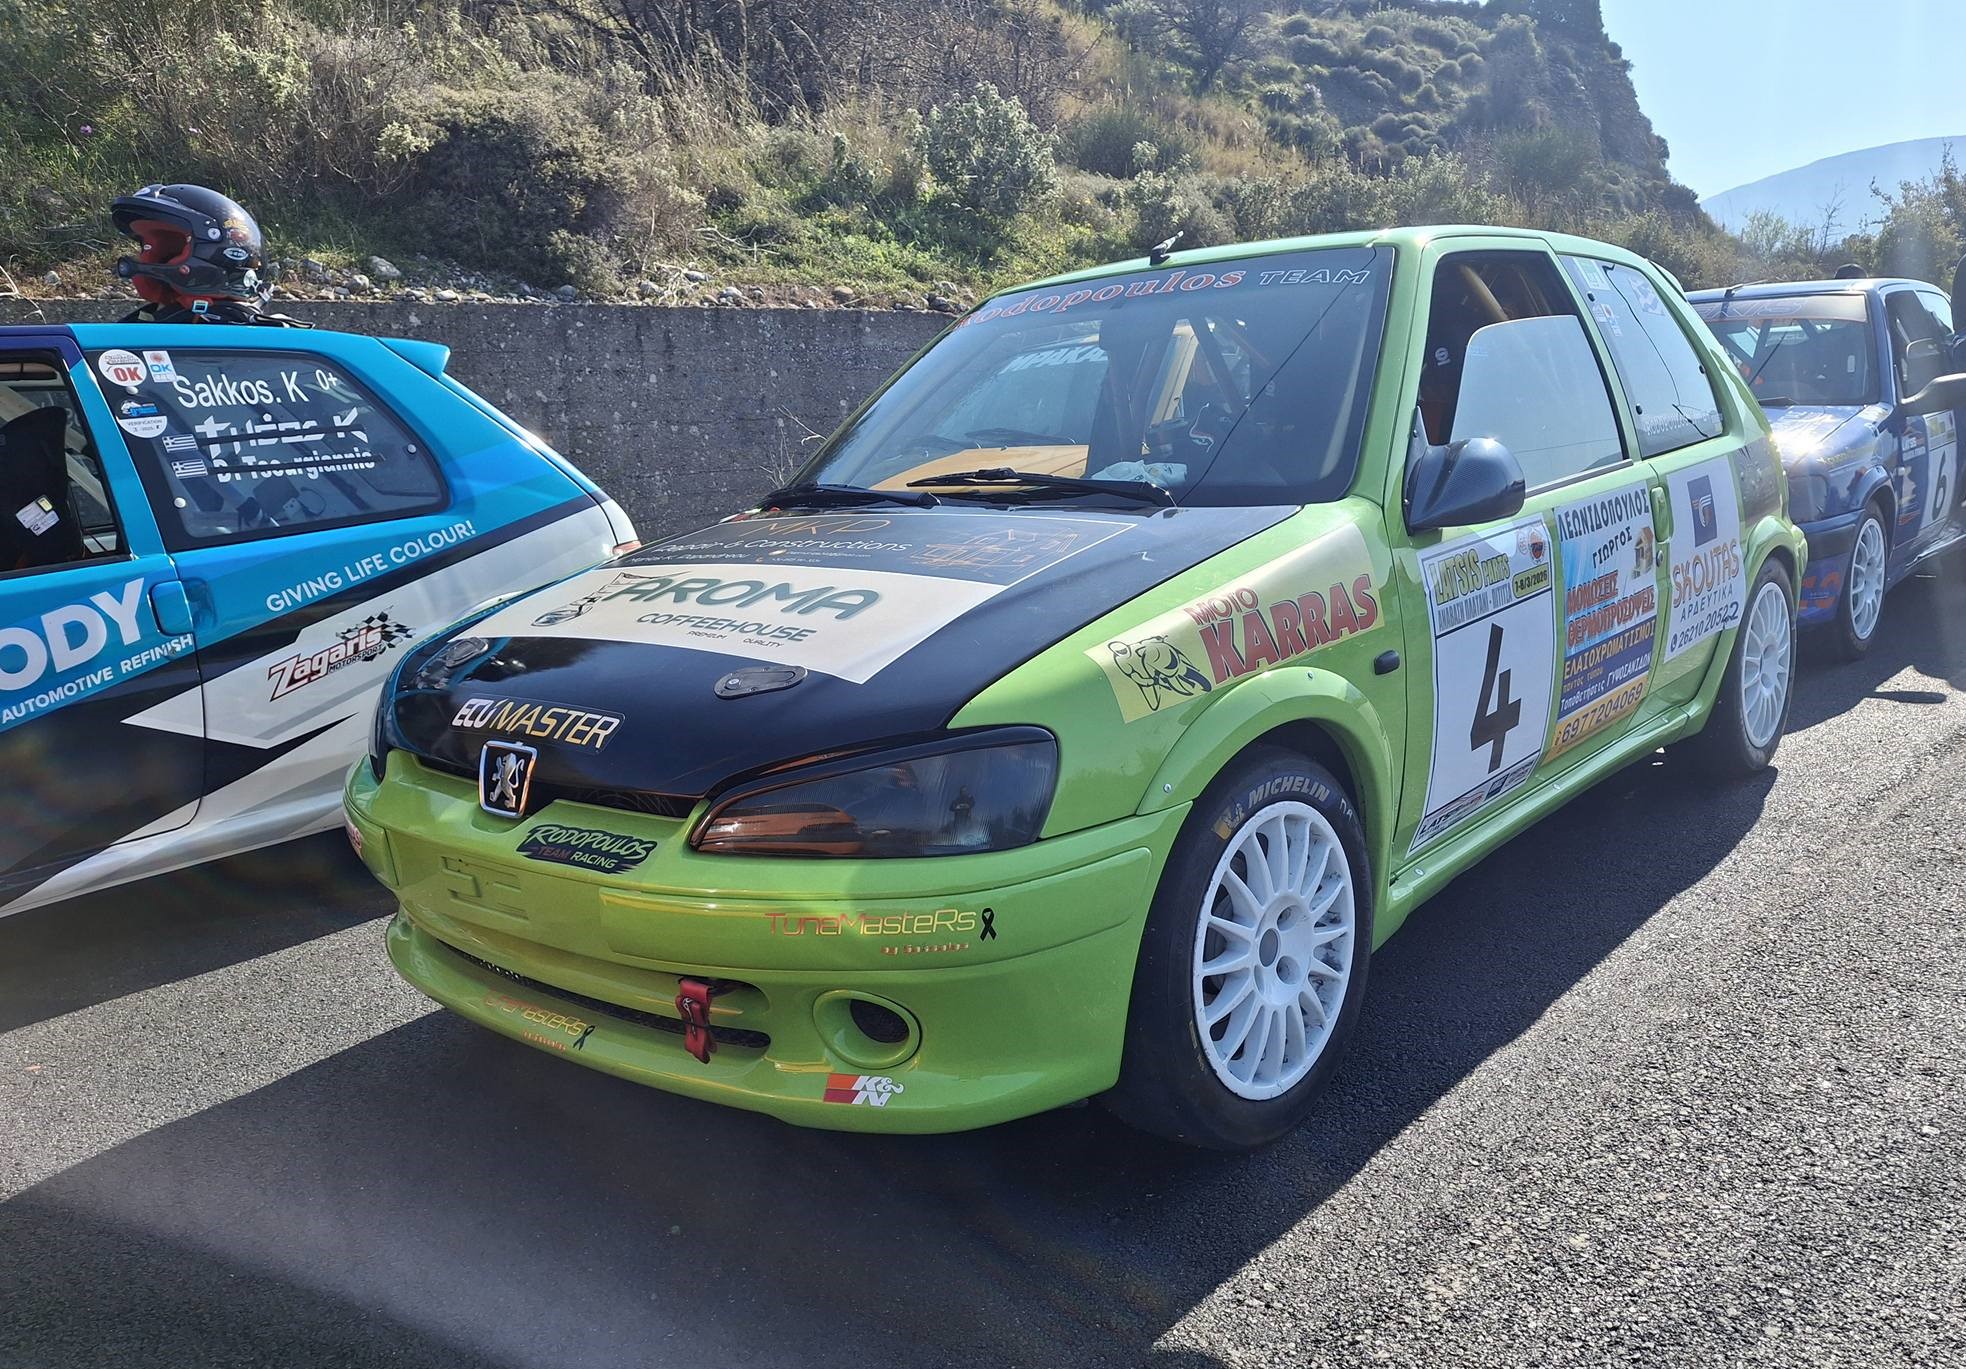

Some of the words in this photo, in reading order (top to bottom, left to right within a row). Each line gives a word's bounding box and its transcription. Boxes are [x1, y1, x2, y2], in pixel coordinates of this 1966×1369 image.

[1259, 269, 1370, 286] TEAM
[113, 367, 143, 382] OK
[149, 364, 172, 373] OK
[173, 375, 280, 408] Sakkos.
[281, 370, 309, 403] K
[1933, 450, 1948, 521] 6
[1557, 488, 1650, 542] ΛΕΩΝΙΔΟΠΟΥΛΟΣ
[266, 571, 343, 612] GIVING
[344, 553, 388, 582] LIFE
[389, 519, 477, 564] COLOUR!
[744, 540, 913, 552] Constructions
[1592, 526, 1633, 568] ΓΙΩΡΓΟΣ
[1428, 548, 1483, 606] LATSIS
[1481, 552, 1511, 588] PARTS
[1672, 538, 1739, 609] SKOUTAS
[600, 578, 880, 620] AROMA
[1184, 586, 1259, 626] MOTO
[1680, 583, 1734, 622] ΑΡΔΕΥΤΙΚΑ
[637, 613, 818, 642] COFFEEHOUSE
[1199, 573, 1379, 685] KARRAS
[268, 626, 384, 702] Zagaris
[328, 643, 386, 673] MOTORSPORT
[1563, 619, 1656, 680] ΕΛΑΙΟΧΡΩΜΑΤΙΣΜΟΙ
[1, 666, 114, 724] AUTOMOTIVE
[120, 632, 193, 674] REFINISH
[1471, 622, 1521, 774] 4
[1561, 682, 1643, 744] 6977204069
[1248, 776, 1331, 809] MICHELIN
[525, 825, 653, 860] RODOPOULOS
[537, 845, 571, 860] TEAM
[570, 851, 619, 869] RACING
